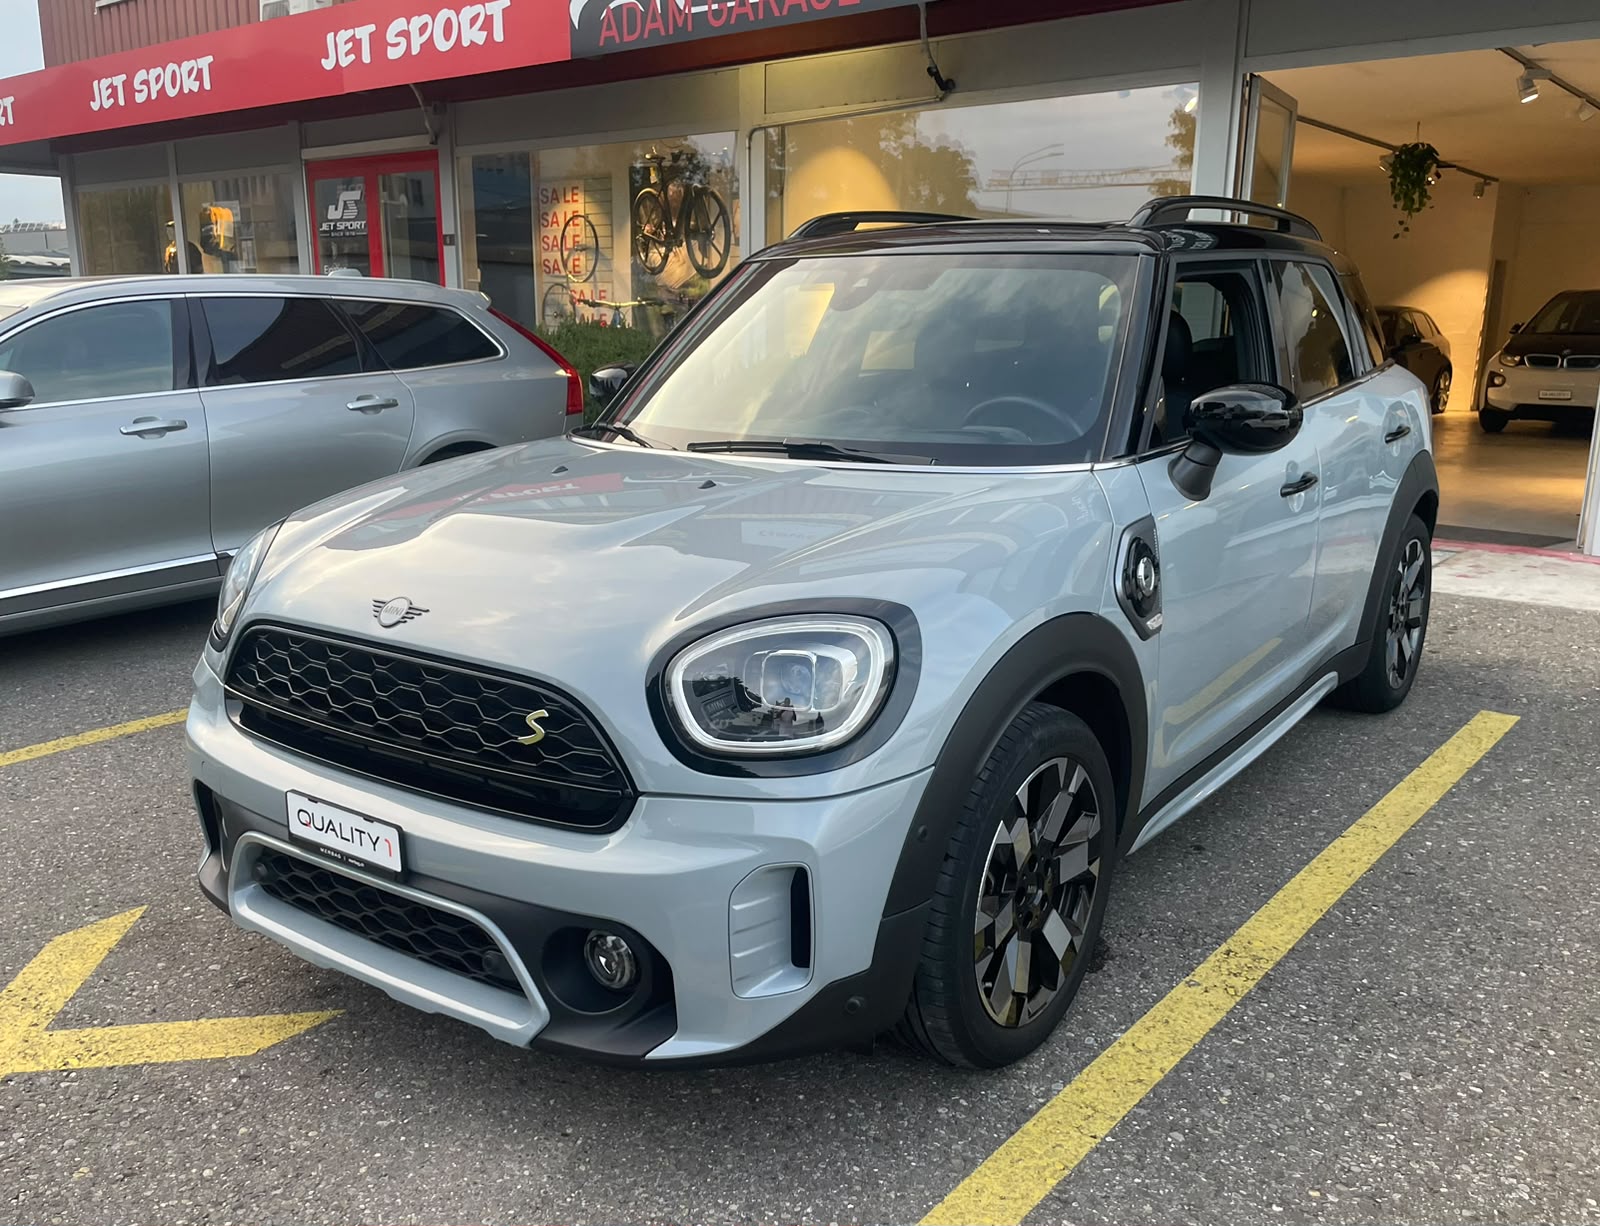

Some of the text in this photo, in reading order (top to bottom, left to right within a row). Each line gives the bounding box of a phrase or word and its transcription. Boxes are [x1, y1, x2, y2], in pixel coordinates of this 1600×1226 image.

[321, 0, 511, 70] JET SPORT
[599, 0, 864, 46] ADAM GAR
[90, 55, 214, 111] JET SPORT
[541, 186, 579, 203] SALE
[320, 221, 366, 231] JET SPORT
[541, 210, 580, 228] SALE
[542, 234, 580, 251] SALE
[543, 257, 581, 275] SAE
[517, 709, 549, 745] S
[297, 808, 380, 852] QUALITY
